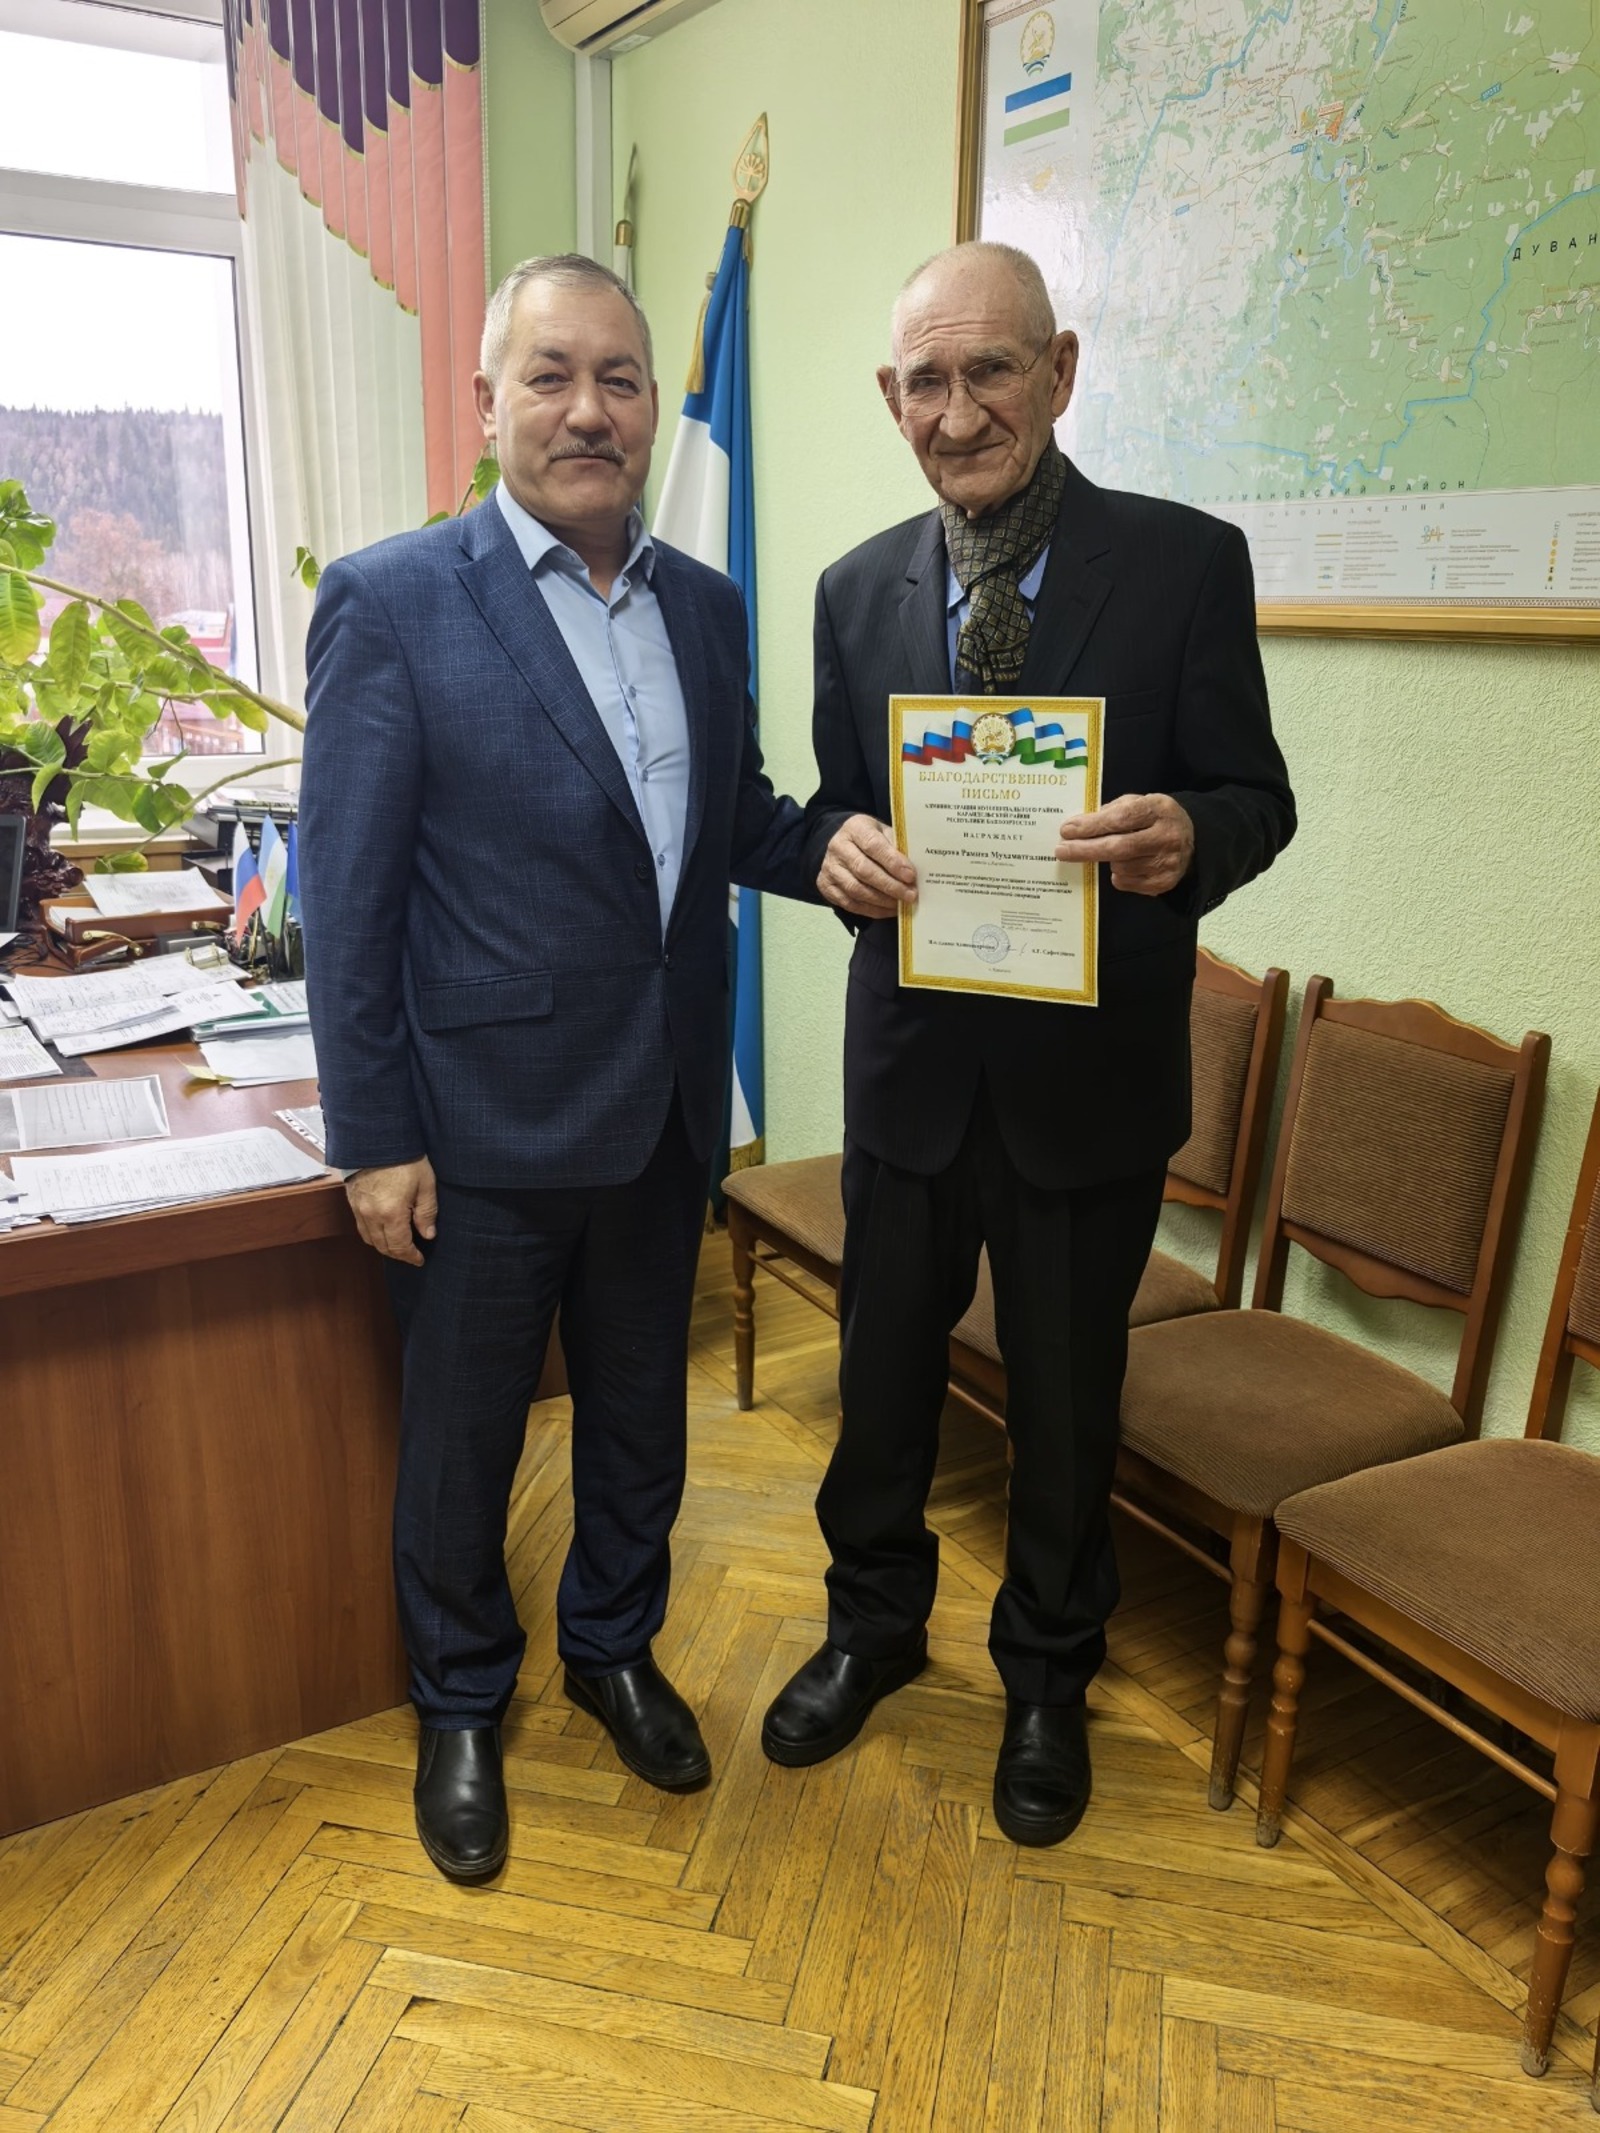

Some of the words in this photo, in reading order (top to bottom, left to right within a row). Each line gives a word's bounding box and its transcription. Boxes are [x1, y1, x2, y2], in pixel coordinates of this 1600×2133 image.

[1512, 233, 1598, 262] ДУВАН
[1389, 481, 1465, 493] РАЙОН
[919, 771, 1068, 786] БЛАГОДАРСТВЕННОЕ
[961, 788, 1021, 801] ПИСЬМО
[963, 832, 1024, 842] НАГРАЖДАЕТ
